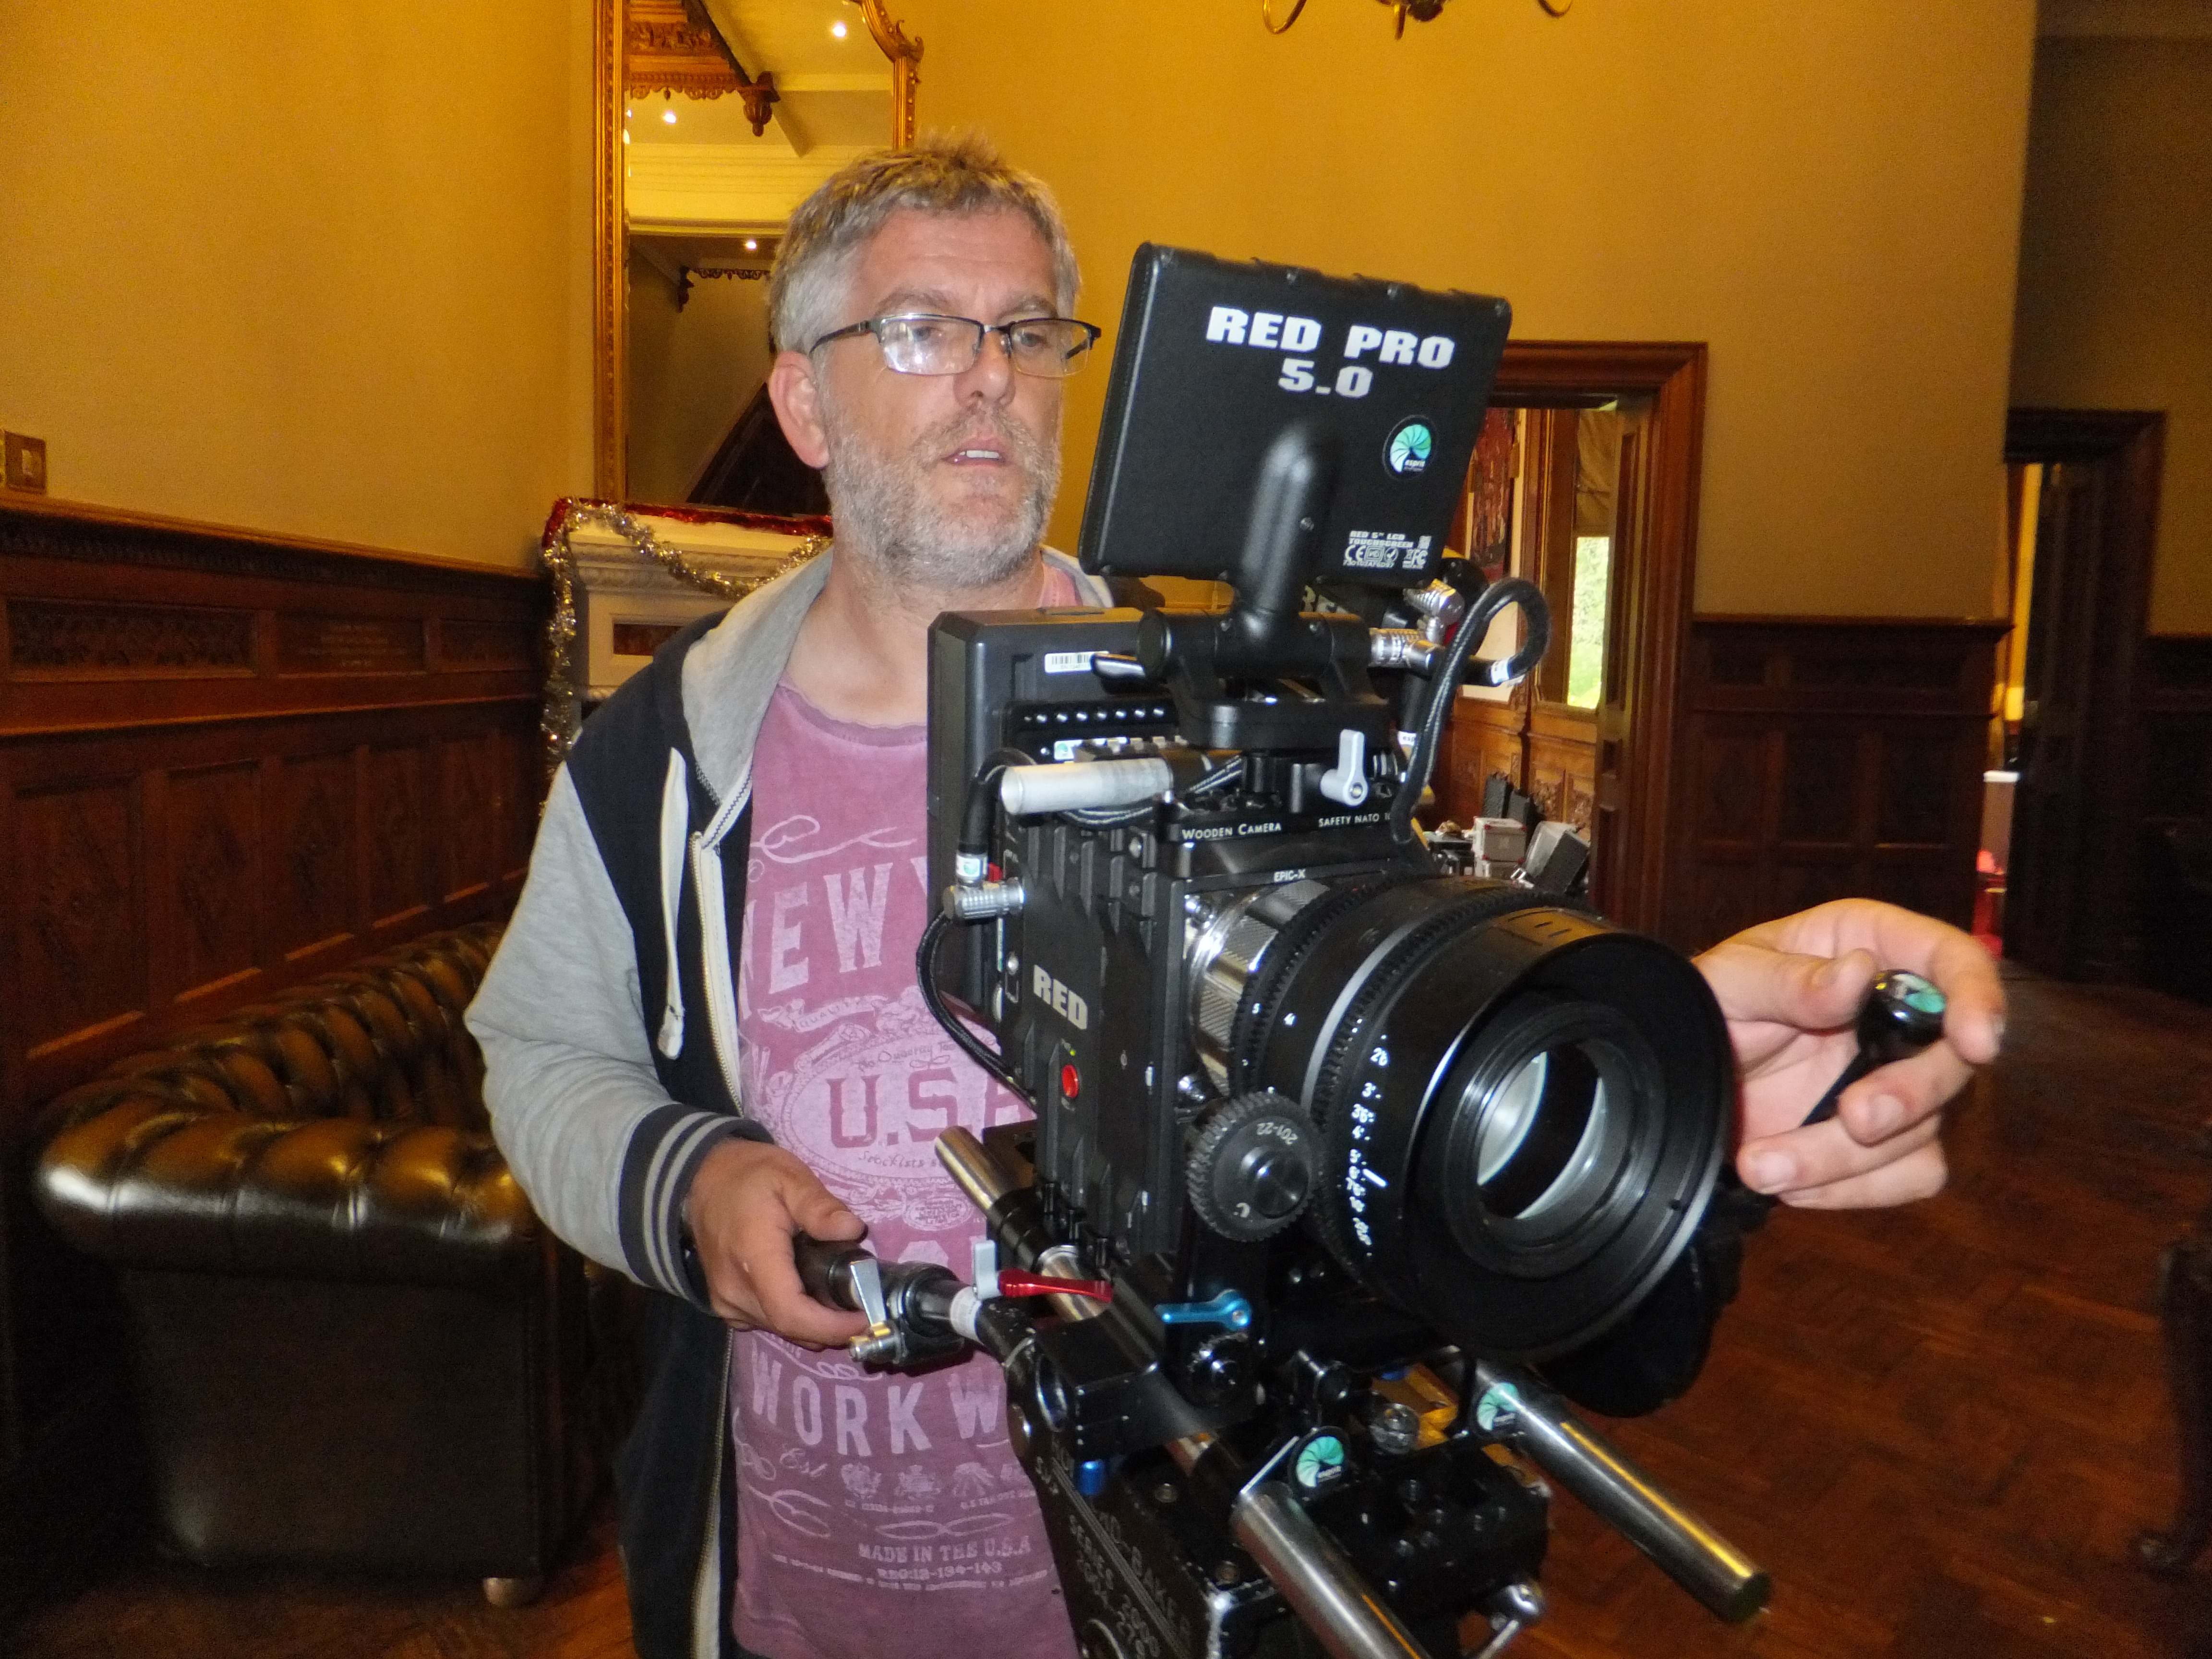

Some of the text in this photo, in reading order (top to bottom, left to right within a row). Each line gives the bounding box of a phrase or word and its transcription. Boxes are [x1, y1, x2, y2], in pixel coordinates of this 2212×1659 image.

[1206, 306, 1455, 370] RED PRO
[1278, 358, 1373, 398] 5.0
[1318, 816, 1352, 828] SAFETY
[1354, 813, 1380, 825] NATO
[1273, 868, 1306, 882] EPIC-X
[1033, 964, 1088, 1030] RED
[752, 1340, 932, 1456] WORK
[914, 1545, 933, 1563] IN
